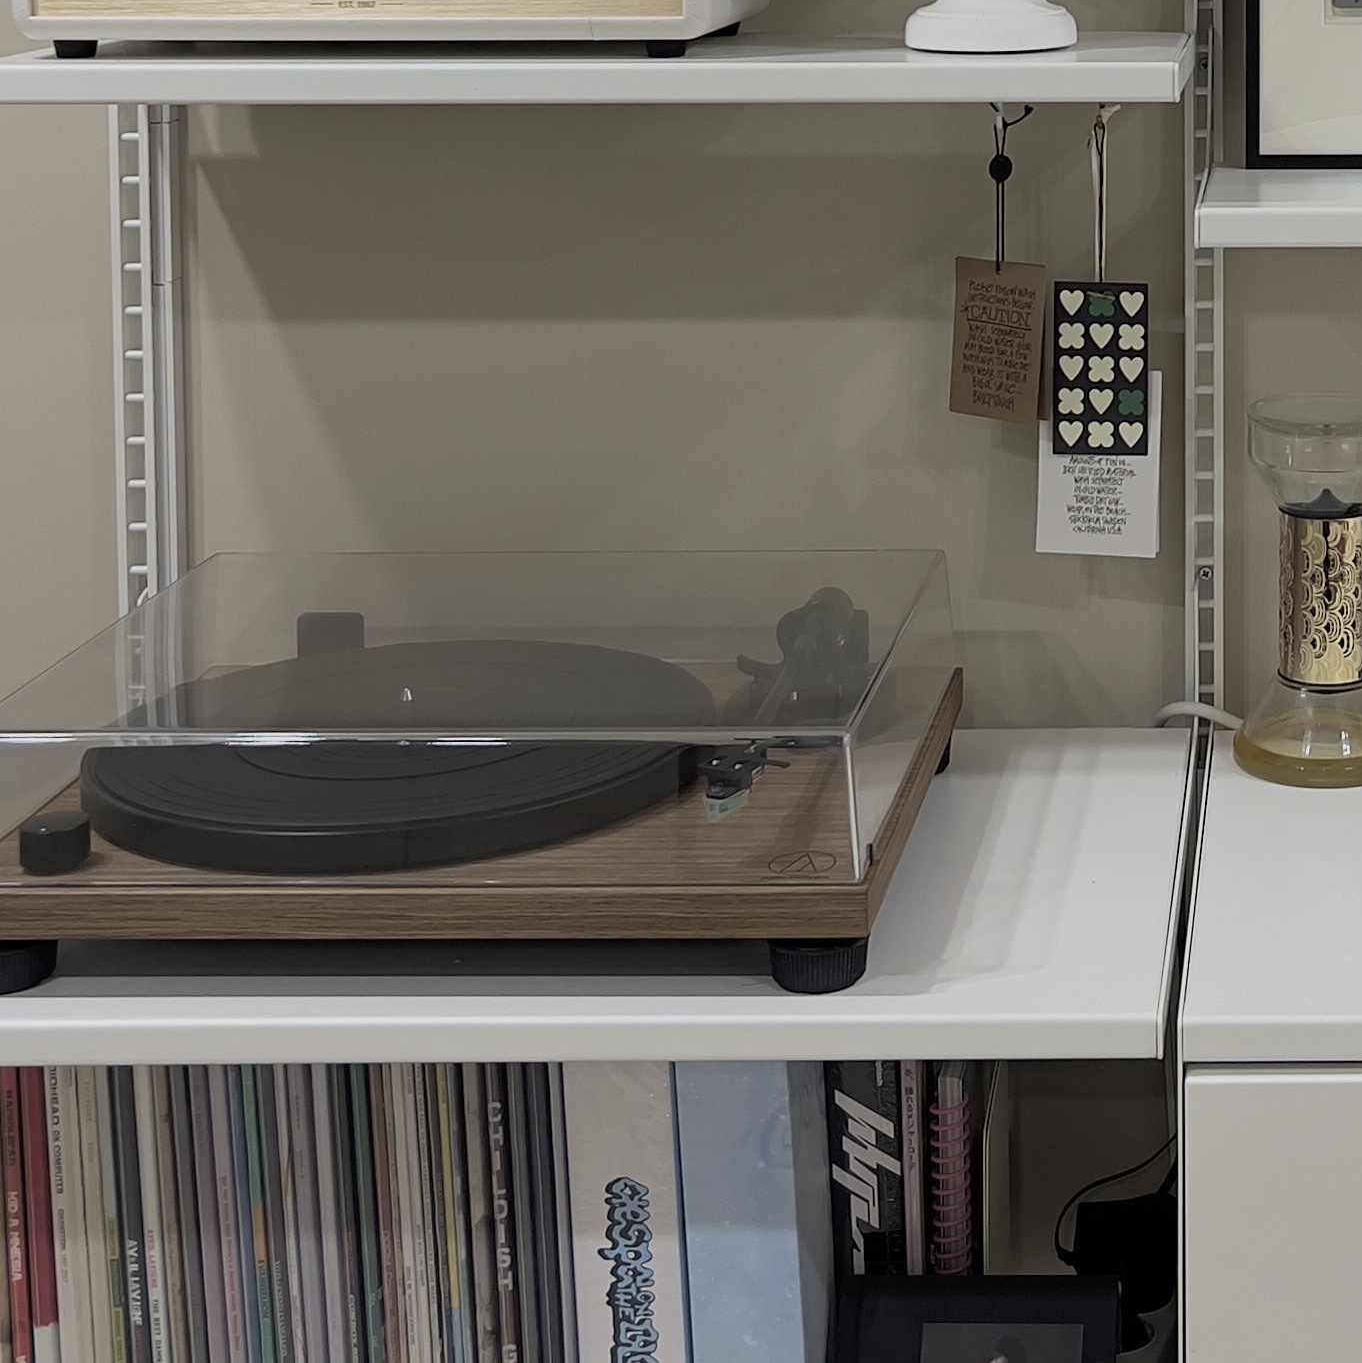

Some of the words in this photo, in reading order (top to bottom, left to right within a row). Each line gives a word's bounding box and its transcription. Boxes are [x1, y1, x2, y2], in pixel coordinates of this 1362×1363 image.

[970, 304, 1032, 327] CAUTION
[54, 1144, 64, 1195] COMPUTER
[7, 1191, 19, 1214] KID
[488, 1102, 513, 1291] CHILDISH
[9, 1218, 19, 1228] A
[147, 1229, 155, 1251] AVRIL
[149, 1254, 158, 1289] LAVIGNE
[153, 1317, 161, 1336] BEST
